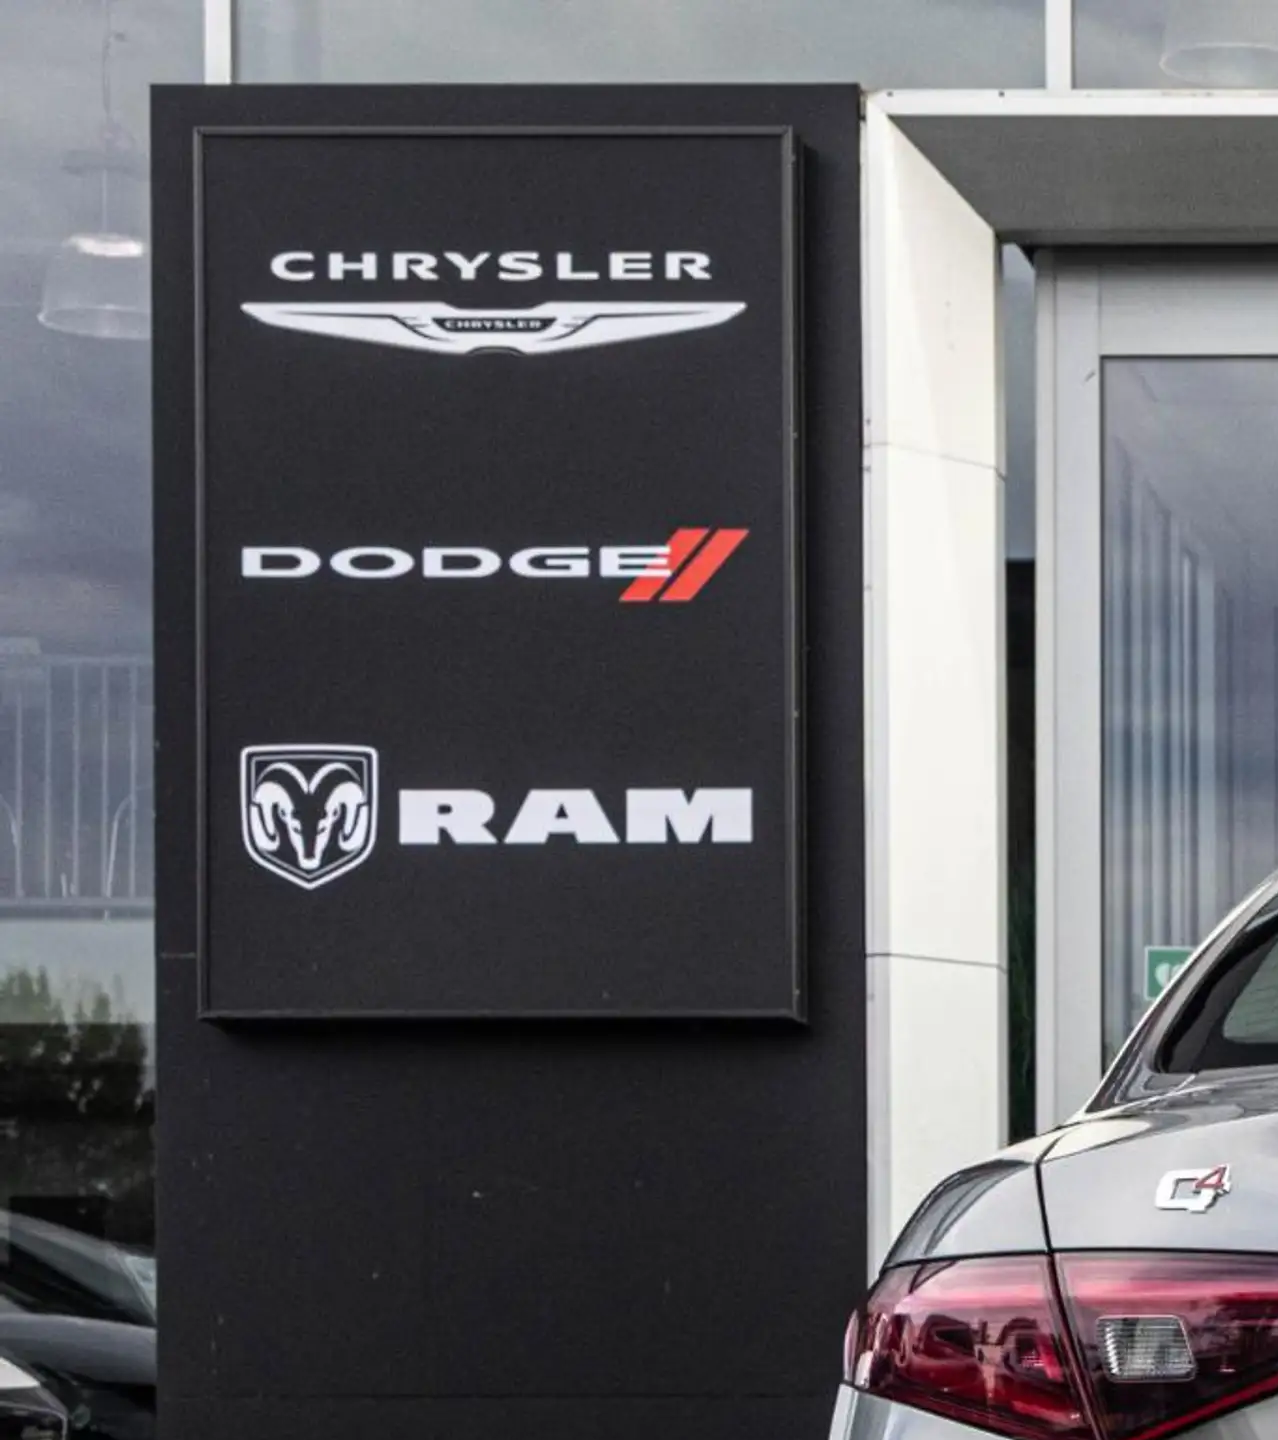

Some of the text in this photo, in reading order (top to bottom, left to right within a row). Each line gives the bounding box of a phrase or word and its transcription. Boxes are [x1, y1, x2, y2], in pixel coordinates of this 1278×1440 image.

[270, 250, 713, 282] CHRYSLER
[241, 546, 673, 579] DODGE
[398, 787, 754, 845] RAM
